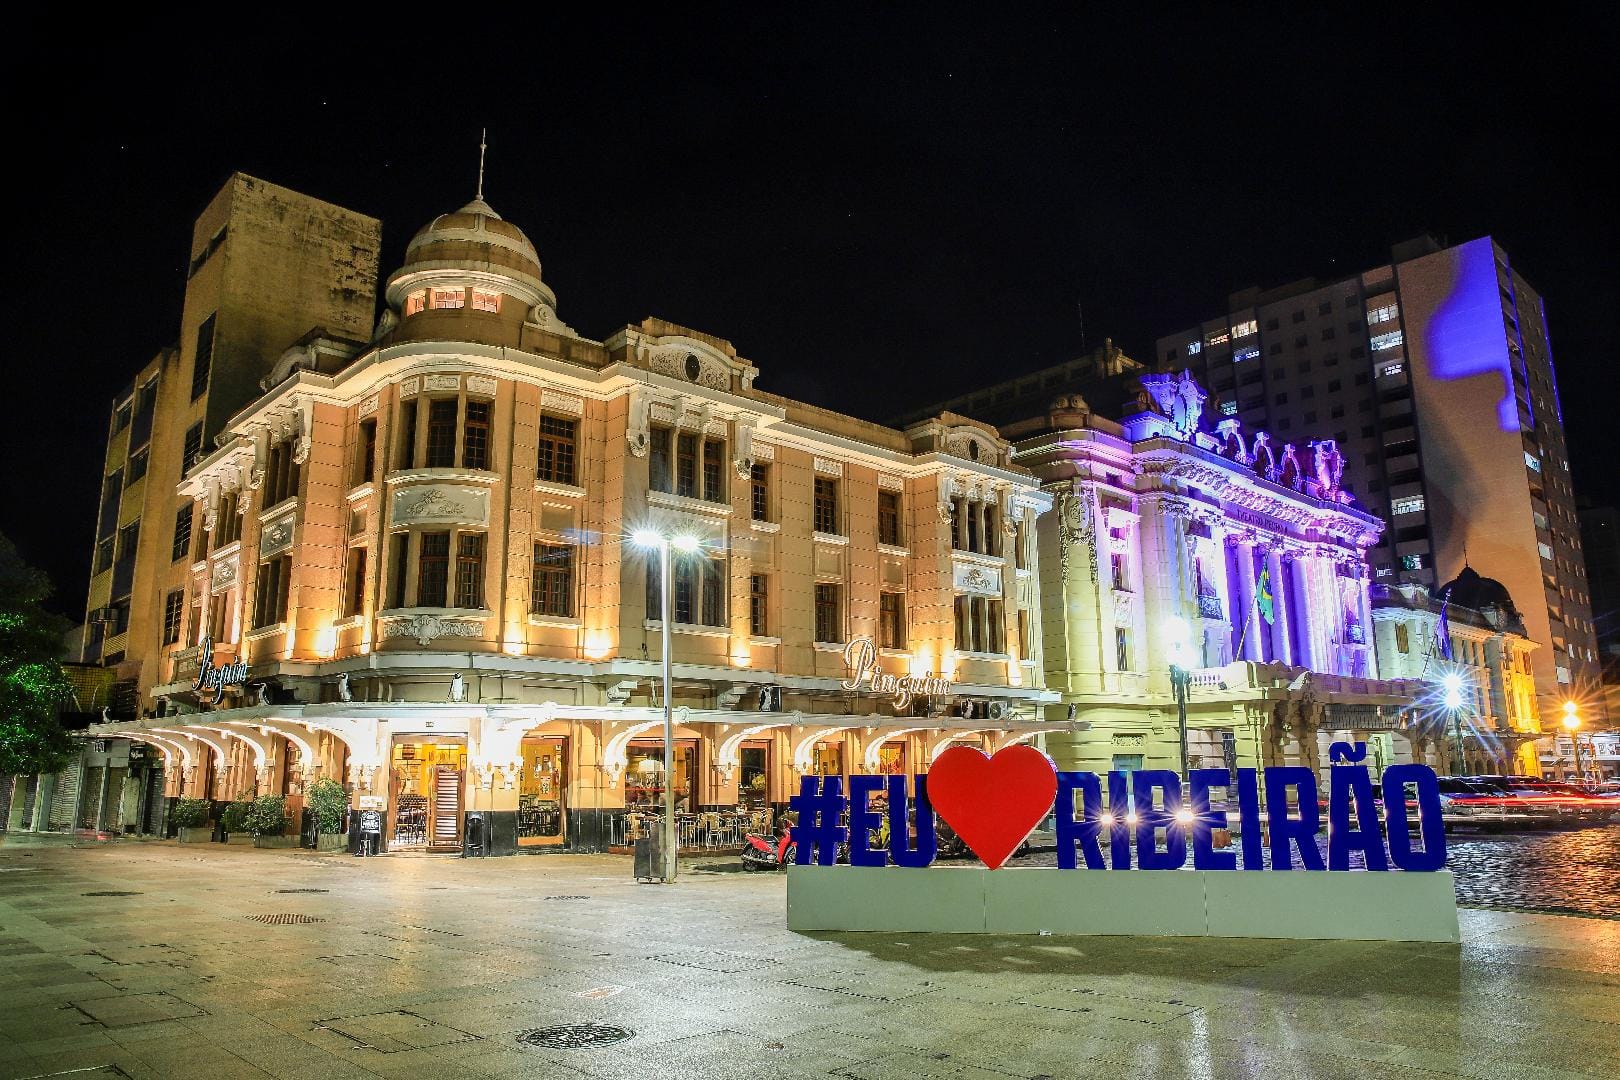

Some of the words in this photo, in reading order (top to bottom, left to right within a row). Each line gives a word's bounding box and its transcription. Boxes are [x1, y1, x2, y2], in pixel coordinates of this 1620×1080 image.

[840, 638, 951, 710] Pinguim
[791, 773, 938, 868] #EU
[1057, 742, 1447, 872] RIBEIRÃO
